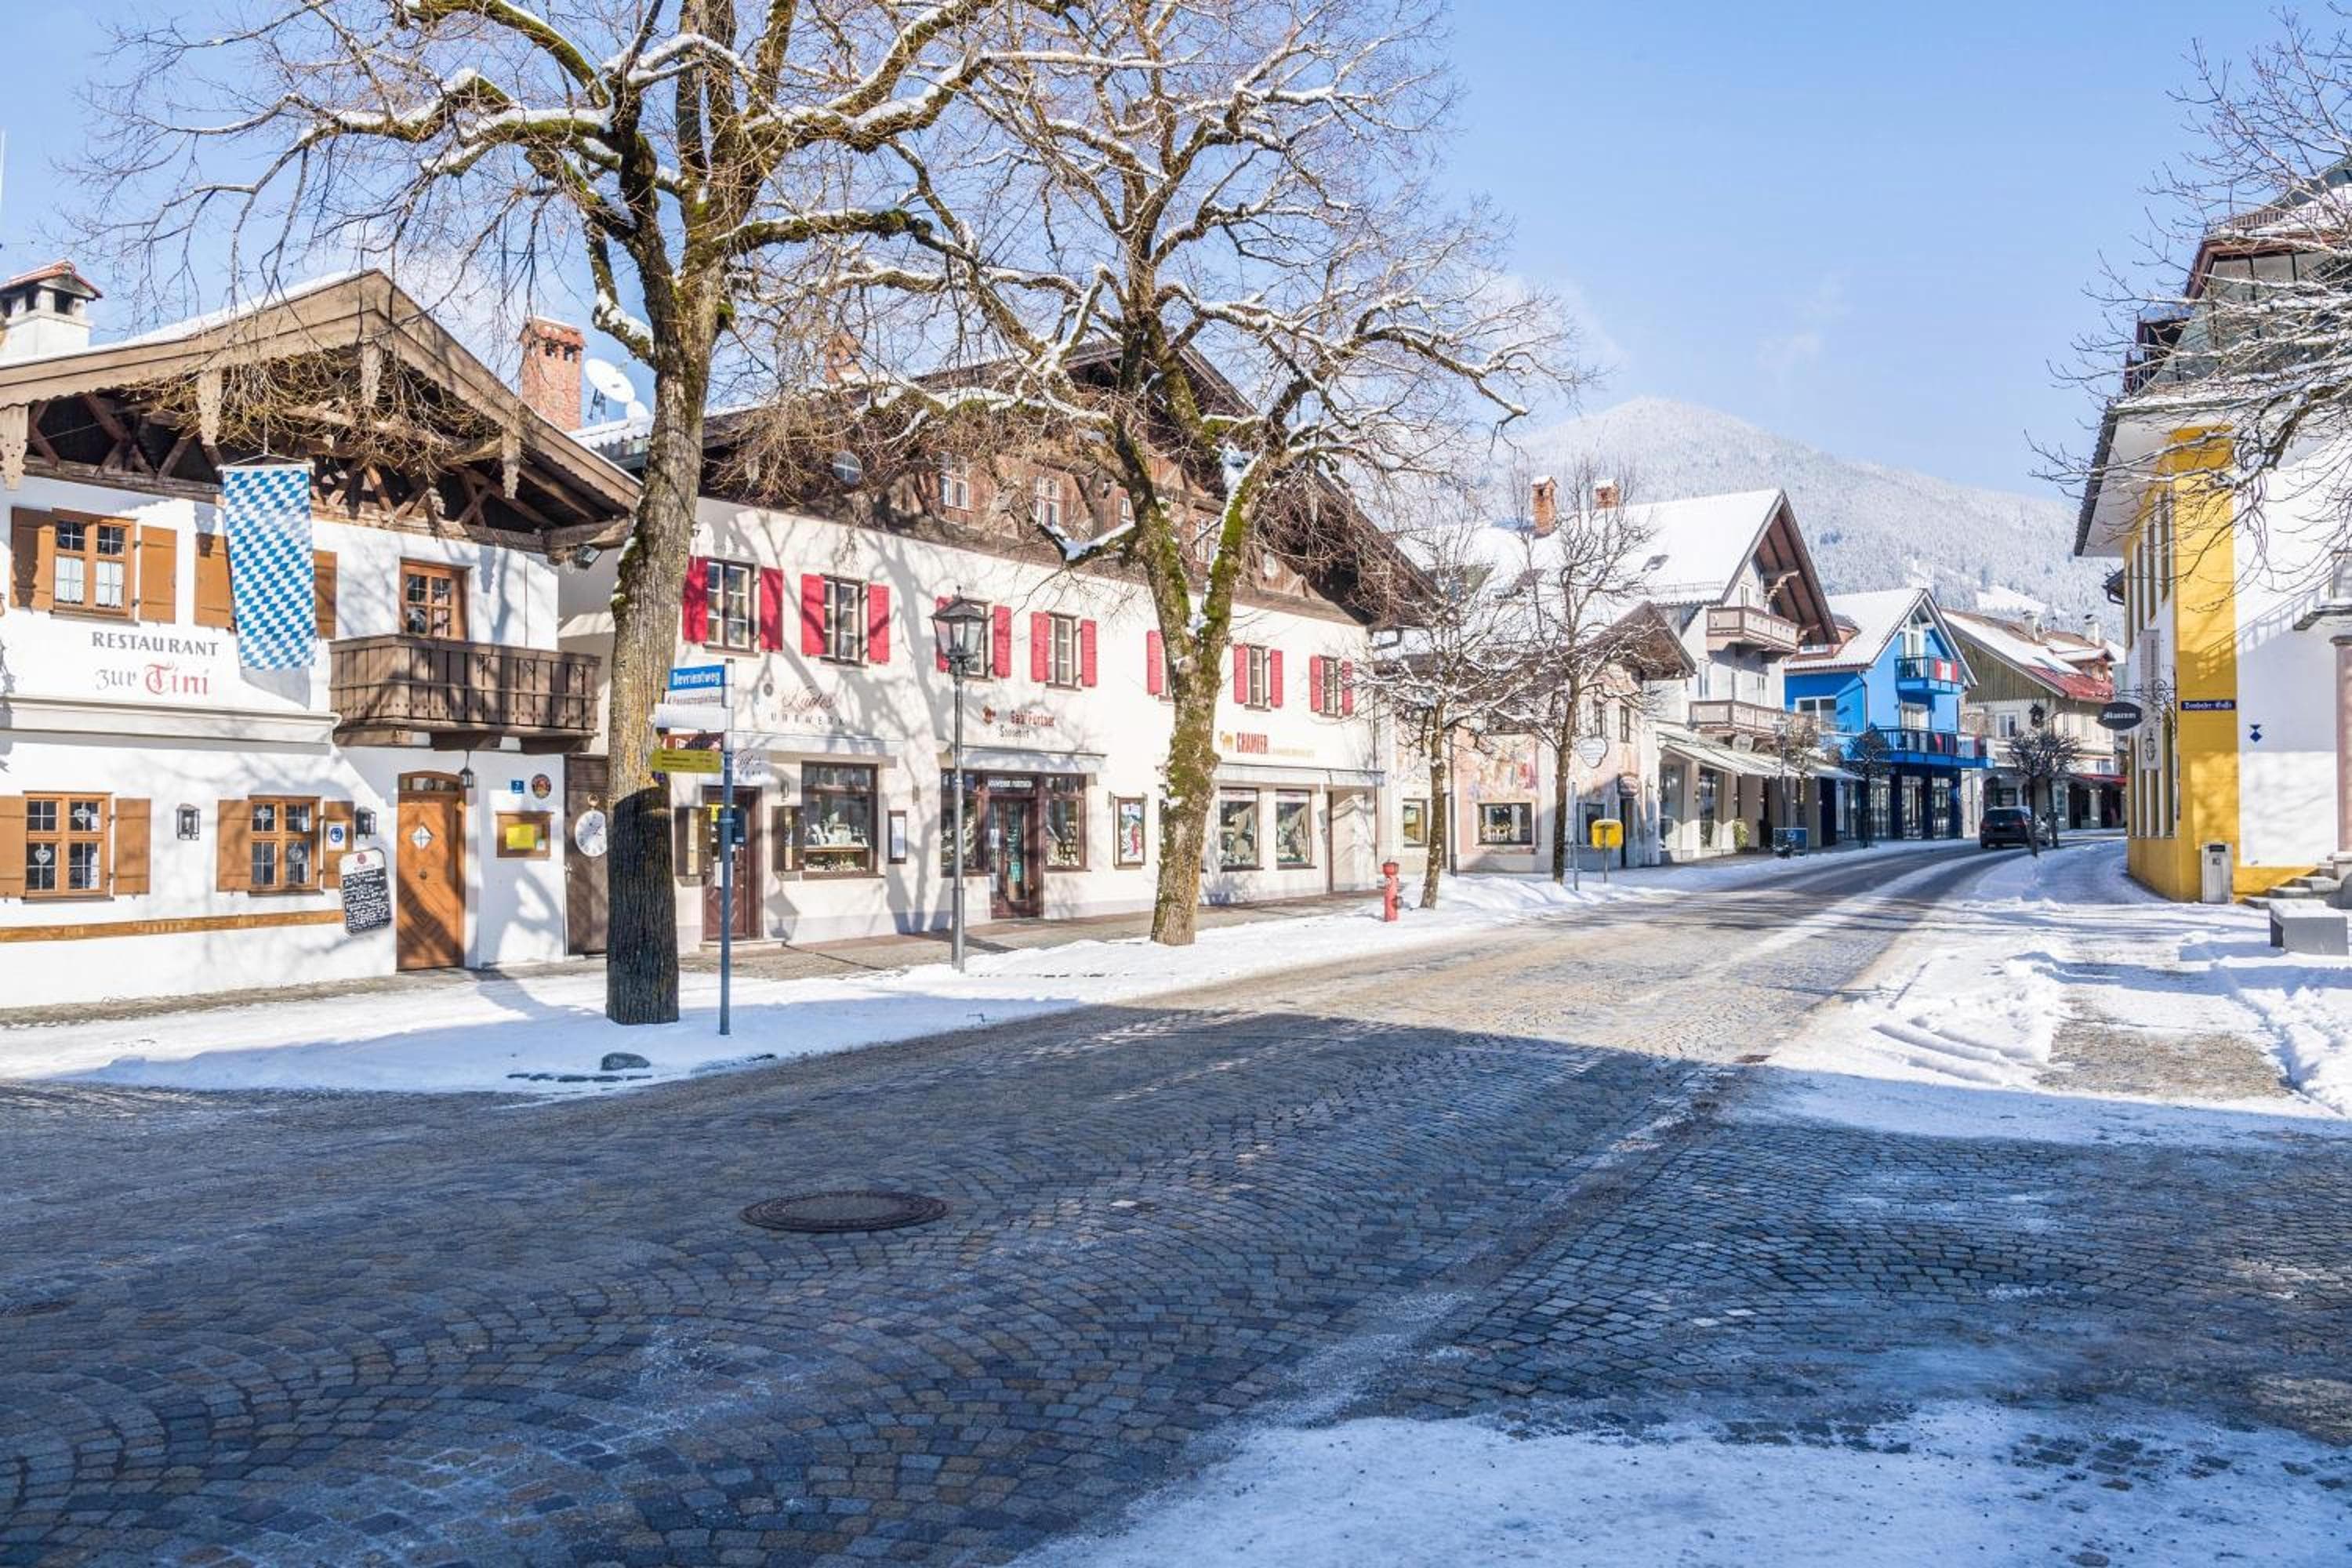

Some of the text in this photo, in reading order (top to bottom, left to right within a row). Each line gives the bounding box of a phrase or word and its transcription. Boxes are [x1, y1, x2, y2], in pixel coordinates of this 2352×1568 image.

[92, 631, 219, 656] RESTAURANT
[144, 662, 209, 695] Tini
[673, 672, 720, 686] Devrientweg
